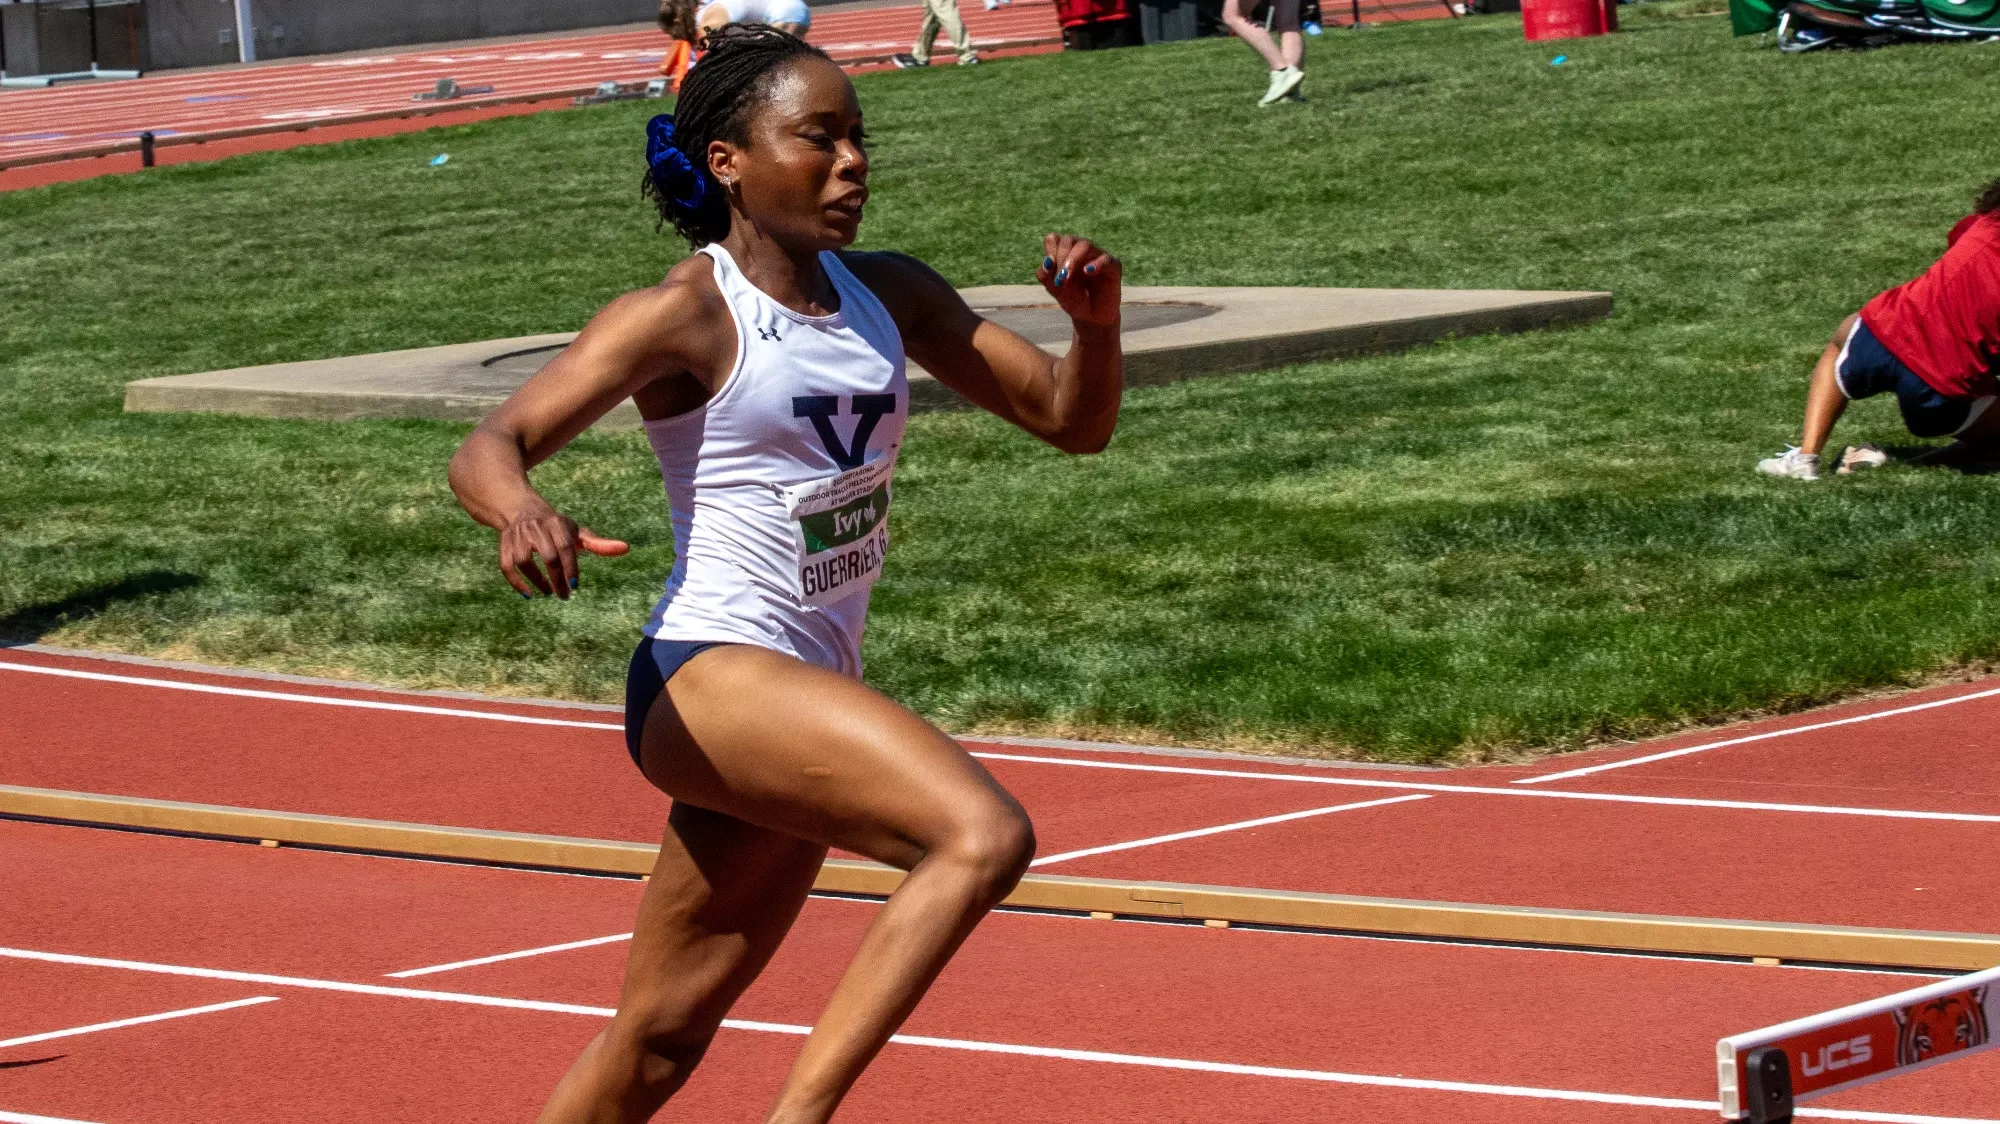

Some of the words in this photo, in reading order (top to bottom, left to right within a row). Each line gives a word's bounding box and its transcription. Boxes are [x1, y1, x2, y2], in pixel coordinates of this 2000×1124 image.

[798, 491, 830, 504] OUTDOOR
[833, 508, 863, 537] Ivy
[802, 537, 880, 597] GUERRIER,
[1801, 1035, 1872, 1077] UCS
